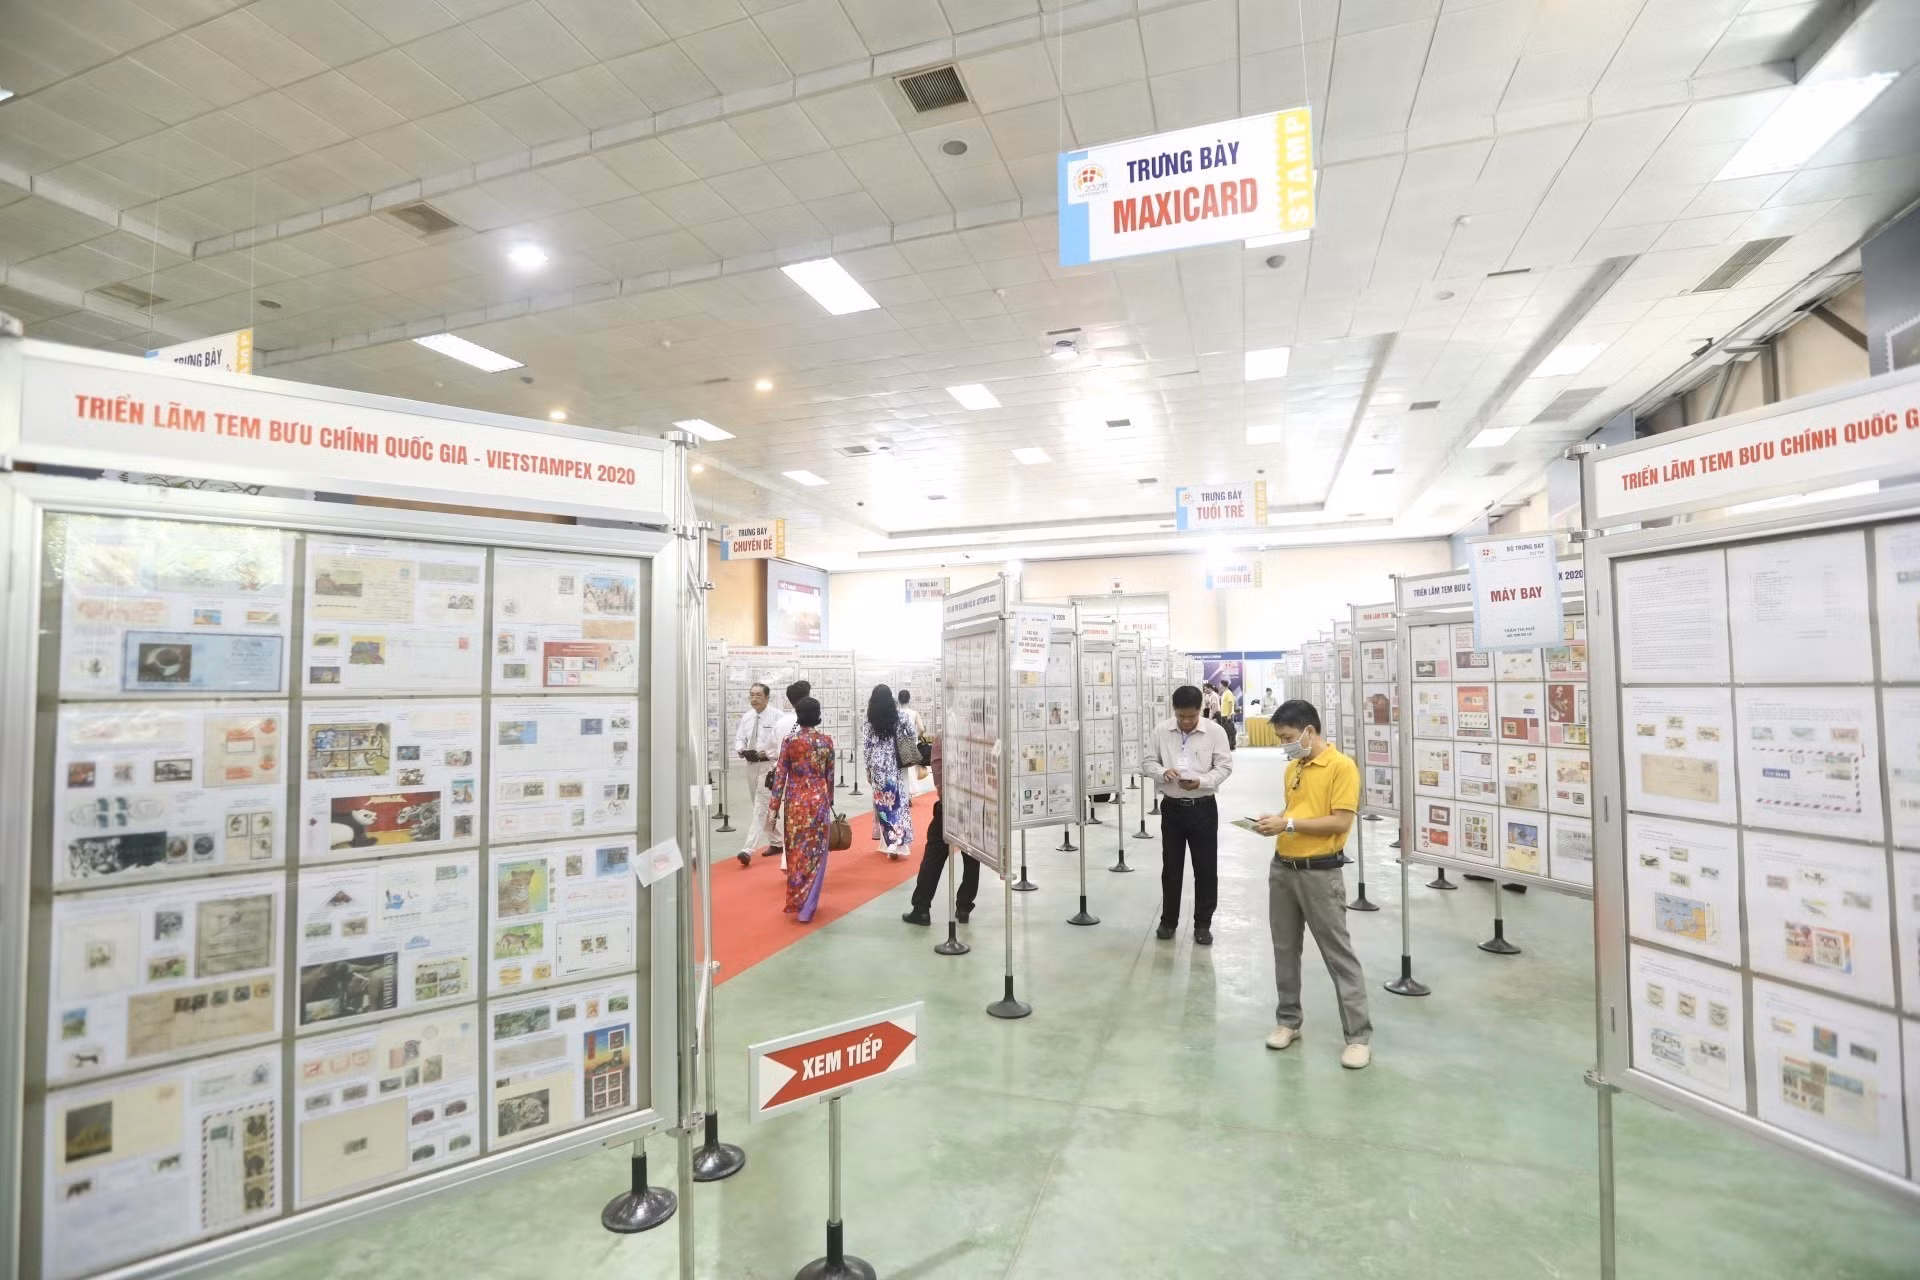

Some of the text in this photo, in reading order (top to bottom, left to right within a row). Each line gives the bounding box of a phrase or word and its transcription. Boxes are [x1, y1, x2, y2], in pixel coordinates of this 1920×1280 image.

[1127, 139, 1240, 184] TRƯNG BÀY
[1285, 114, 1310, 223] STAMP
[1112, 177, 1259, 234] MAXICARD
[75, 391, 146, 425] TRIỂN
[153, 401, 208, 433] LÃM
[213, 411, 262, 441] TEM
[268, 420, 313, 447] BƯU
[318, 423, 379, 455] CHÍNH
[384, 429, 435, 462] QUỐC
[439, 443, 469, 466] GIA
[486, 449, 593, 481] VIETSTAMPEX
[597, 463, 637, 486] 2020
[1621, 463, 1660, 491] TRIỂN
[1662, 458, 1697, 483] LÃM
[1699, 449, 1734, 475] TEM
[1738, 441, 1777, 468] BƯU
[1779, 427, 1840, 458] CHÍNH
[1843, 409, 1899, 444] QUỐC
[1200, 489, 1242, 502] TRƯNG BÀY
[1196, 499, 1245, 520] TUỔI TRẺ
[738, 528, 756, 537] TRƯNG
[733, 535, 773, 553] CHUYÊN ĐỀ
[1564, 569, 1584, 580] 2020
[1441, 584, 1453, 594] TEM
[1490, 586, 1542, 603] MÁY BAY
[802, 1033, 883, 1081] XEM TIẾP
